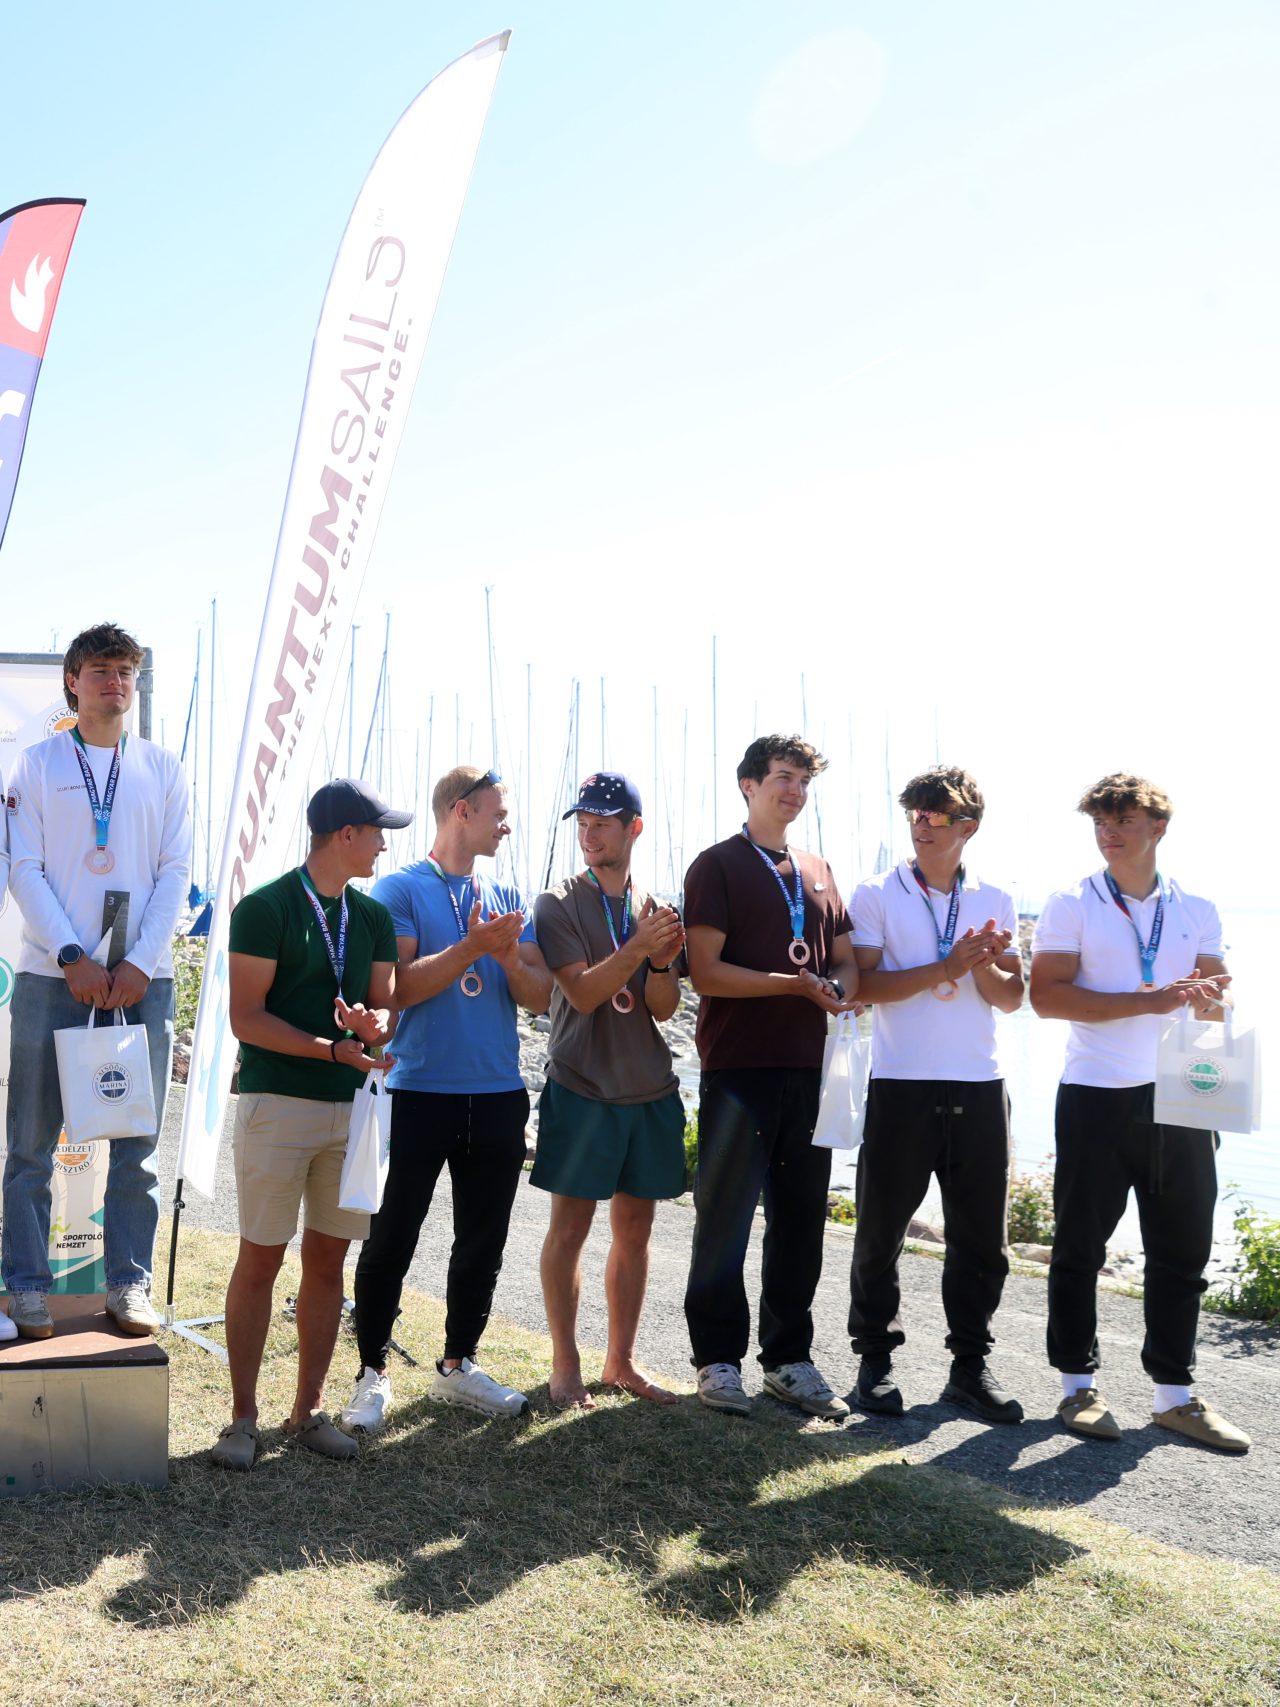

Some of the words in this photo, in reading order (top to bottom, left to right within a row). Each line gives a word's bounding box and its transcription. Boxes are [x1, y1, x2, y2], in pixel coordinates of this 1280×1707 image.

[304, 585, 338, 695] NEXT
[340, 317, 414, 570] CHALLENGE.
[108, 896, 115, 905] 3
[56, 1144, 91, 1153] EDÉLZET
[63, 1231, 103, 1241] SPORTOLÓ
